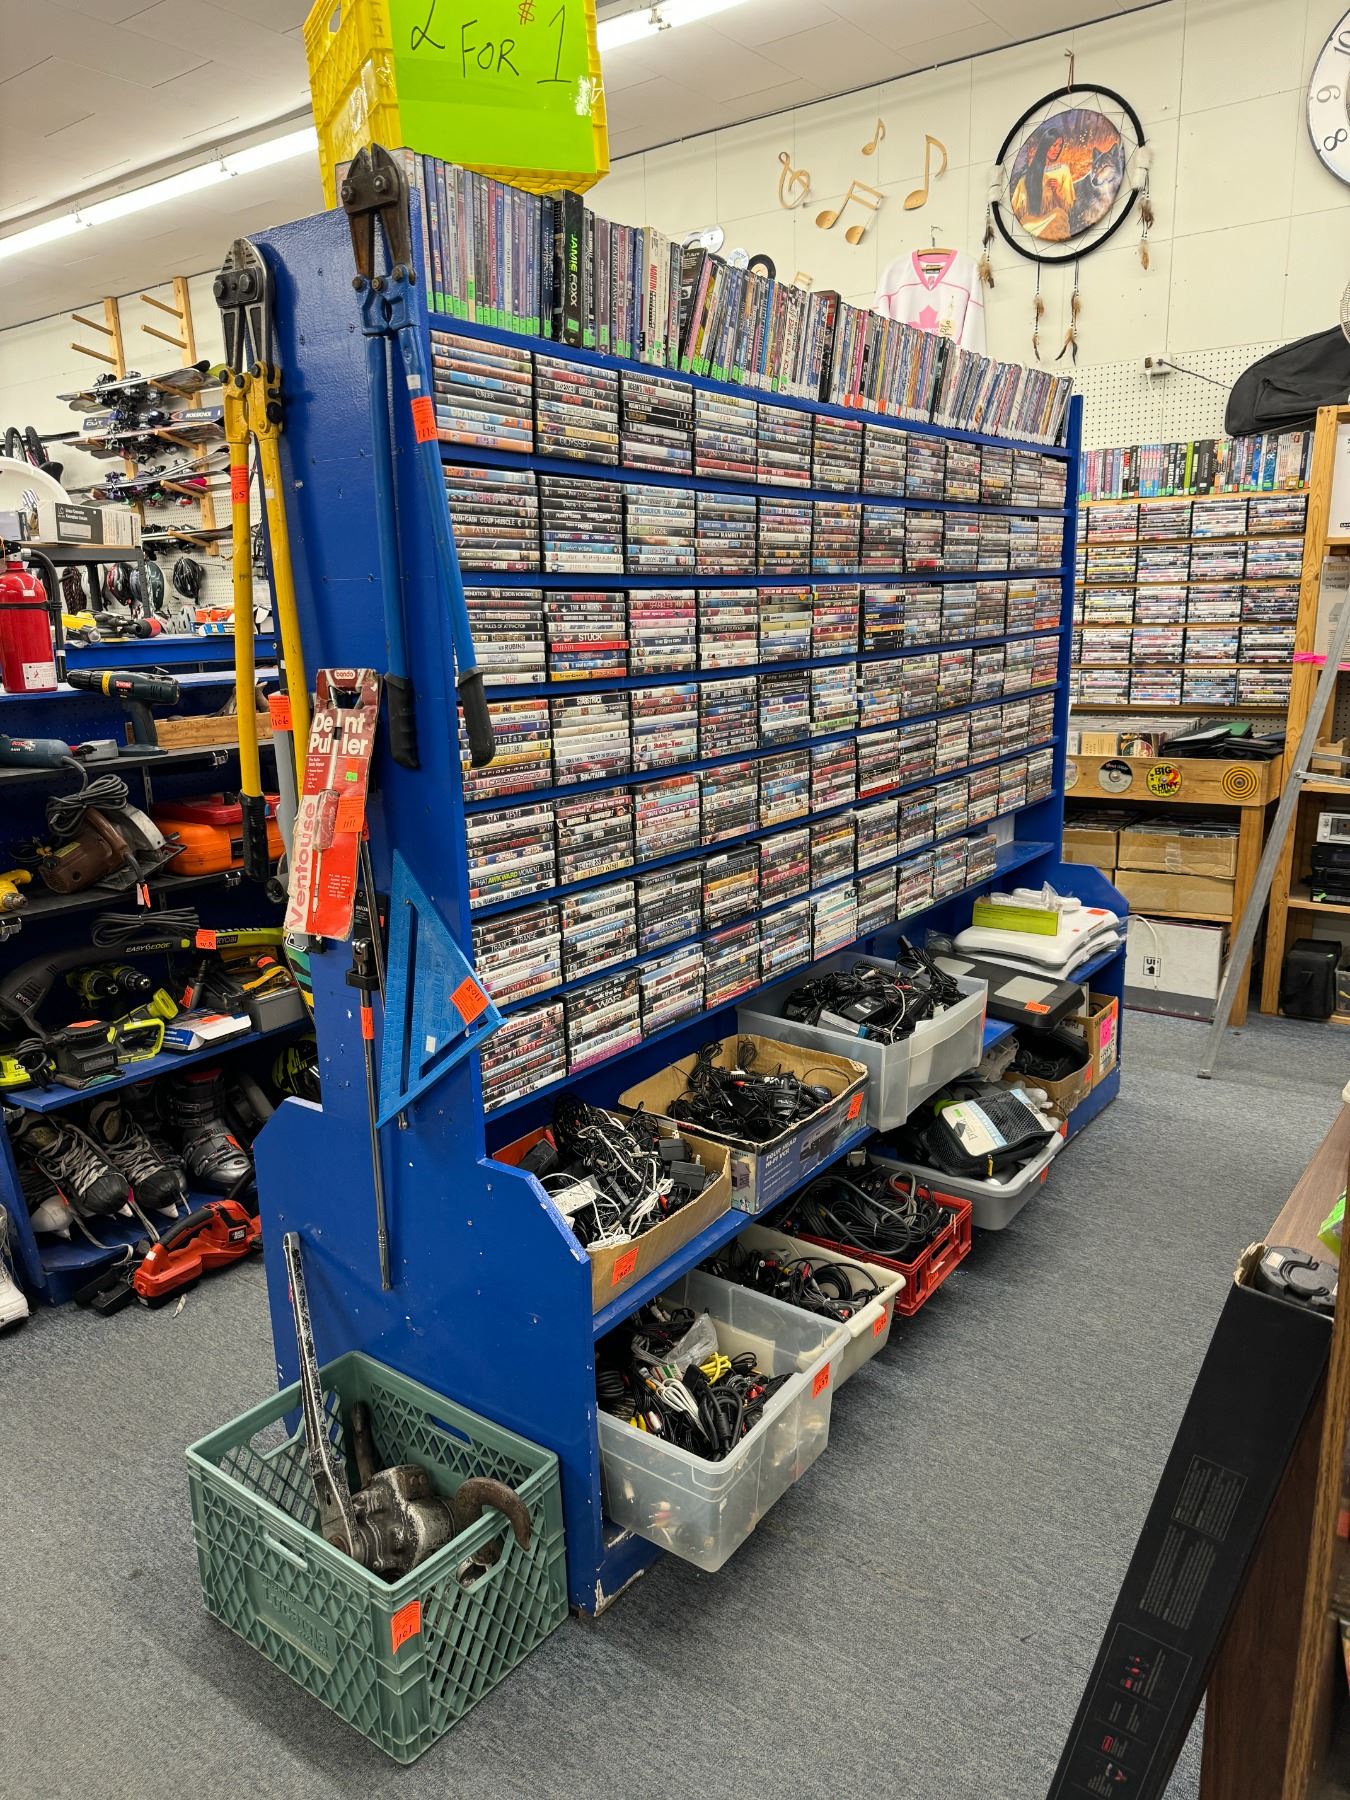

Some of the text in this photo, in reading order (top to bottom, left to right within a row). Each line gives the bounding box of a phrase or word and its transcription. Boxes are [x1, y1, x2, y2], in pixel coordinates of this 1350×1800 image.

[460, 19, 520, 78] FOR
[1316, 85, 1341, 104] 9
[1323, 128, 1348, 152] 8
[570, 233, 579, 308] JAMIE FOXX
[649, 263, 657, 291] MARTIN
[482, 424, 497, 433] Last
[559, 438, 592, 448] ODYSSEY
[578, 633, 603, 642] STUCK
[504, 643, 526, 651] RUBINS
[652, 756, 679, 767] STATESIDE
[1154, 766, 1172, 775] BIG
[1151, 781, 1179, 791] SHINY
[487, 814, 501, 823] STAY
[287, 801, 316, 929] Ventouse
[588, 862, 619, 876] THIRD WISH
[475, 866, 541, 886] THAT AWKWARD MOMENT
[150, 943, 172, 951] EDGE
[216, 936, 237, 944] RYOBI
[490, 939, 512, 953] TRANCE
[592, 993, 605, 1001] walk
[613, 986, 623, 994] line
[596, 994, 622, 1008] WAR
[500, 1012, 545, 1033] WEDDING DAZE
[782, 1137, 798, 1151] HEAD
[765, 1148, 791, 1169] HI-FI VCR
